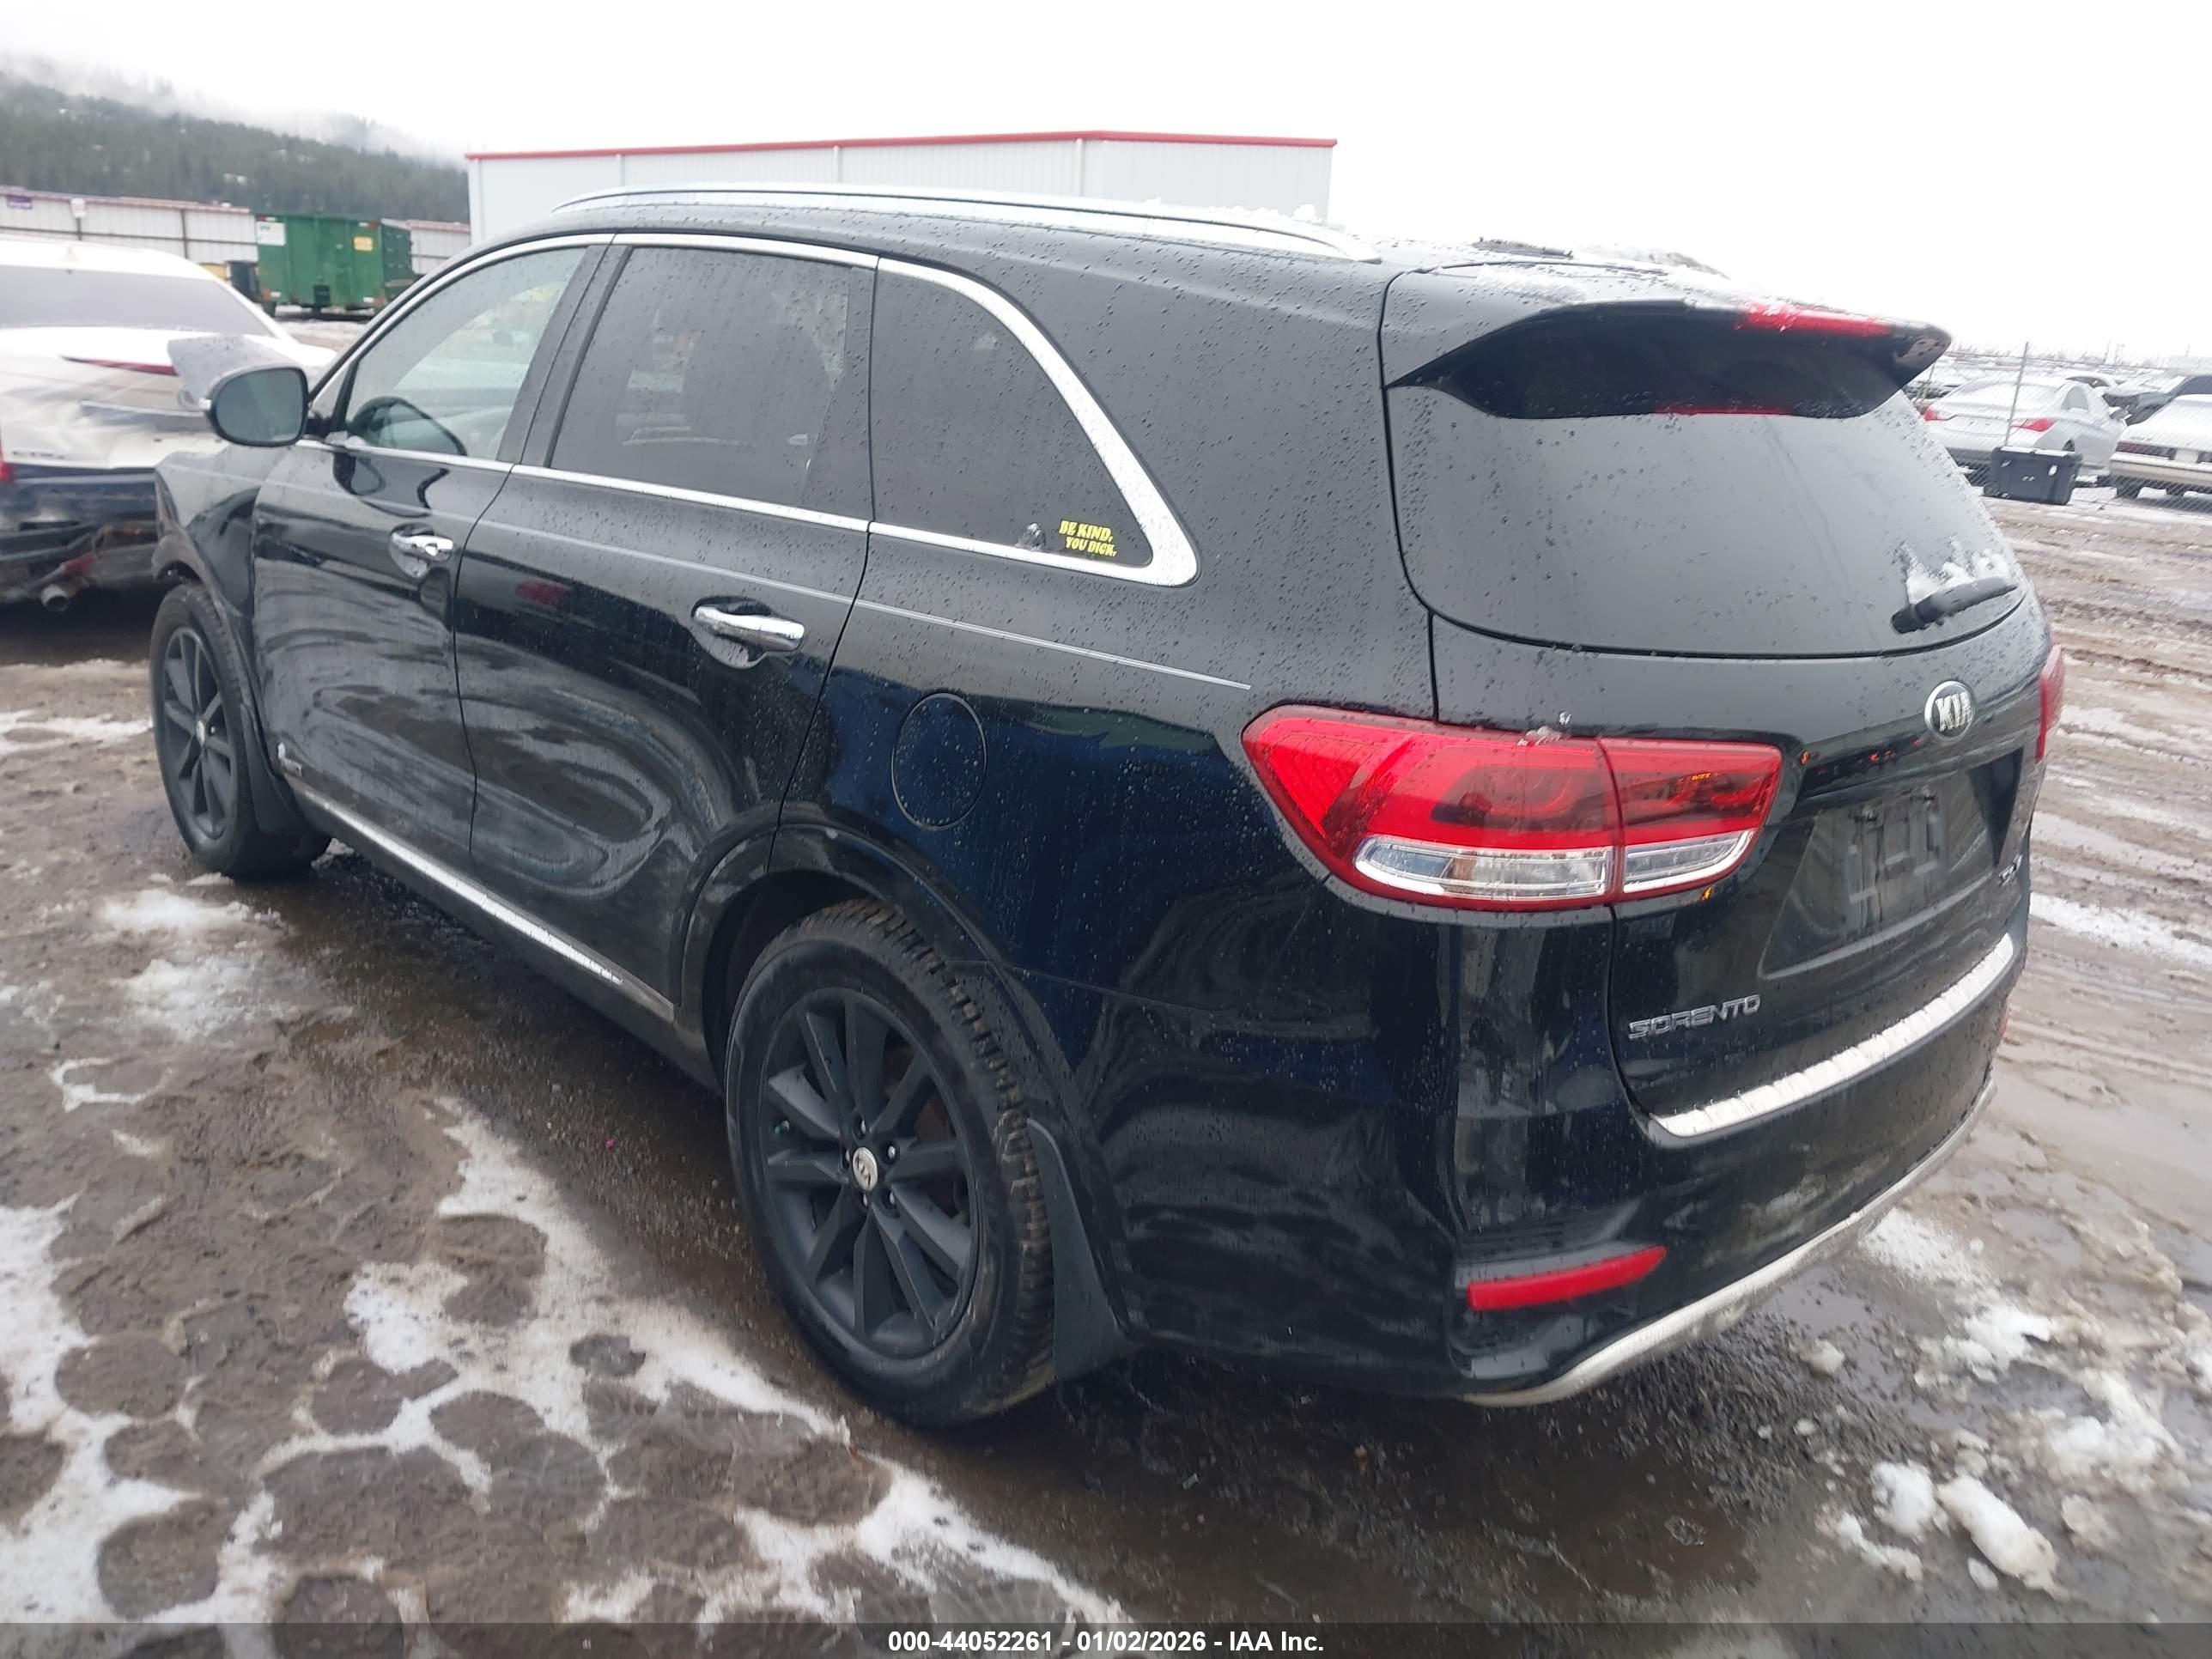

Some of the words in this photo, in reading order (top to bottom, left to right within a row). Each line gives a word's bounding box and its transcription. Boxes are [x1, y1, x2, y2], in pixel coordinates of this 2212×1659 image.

[1059, 520, 1078, 536] BE
[1066, 536, 1089, 551] YOU
[1935, 691, 1972, 732] KIA
[1628, 994, 1760, 1040] SORENTO
